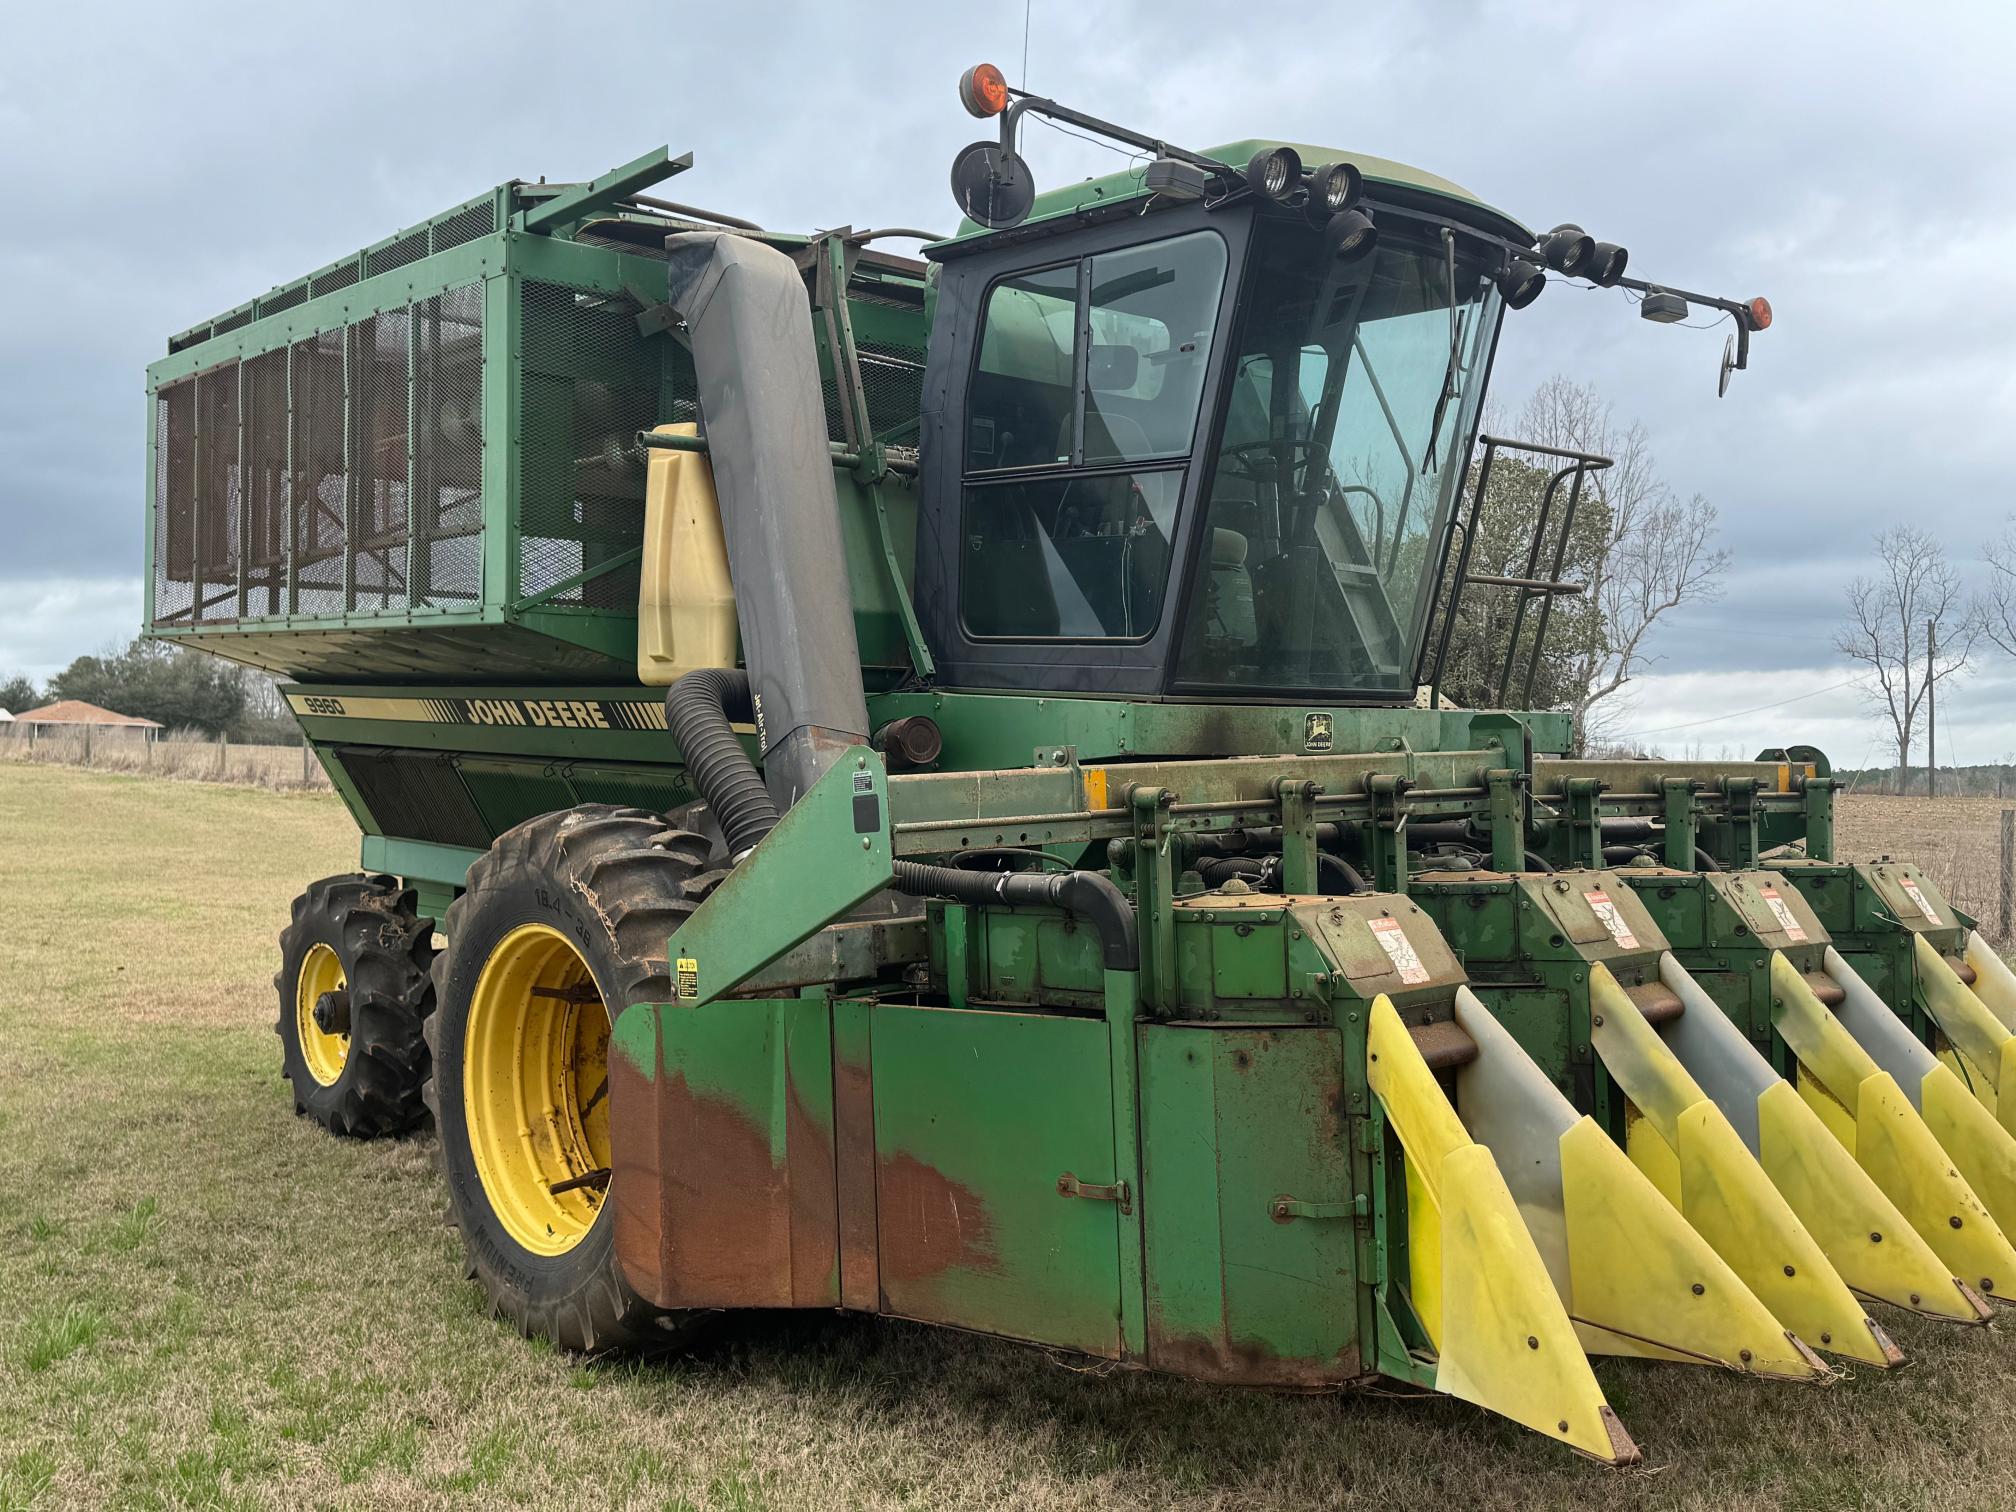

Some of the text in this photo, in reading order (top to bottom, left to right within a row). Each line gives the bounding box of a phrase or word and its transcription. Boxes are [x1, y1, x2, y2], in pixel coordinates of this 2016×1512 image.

[304, 697, 346, 715] 9960
[465, 699, 611, 729] JOHN DEERE
[534, 888, 560, 914] 18.4
[576, 918, 591, 949] 38
